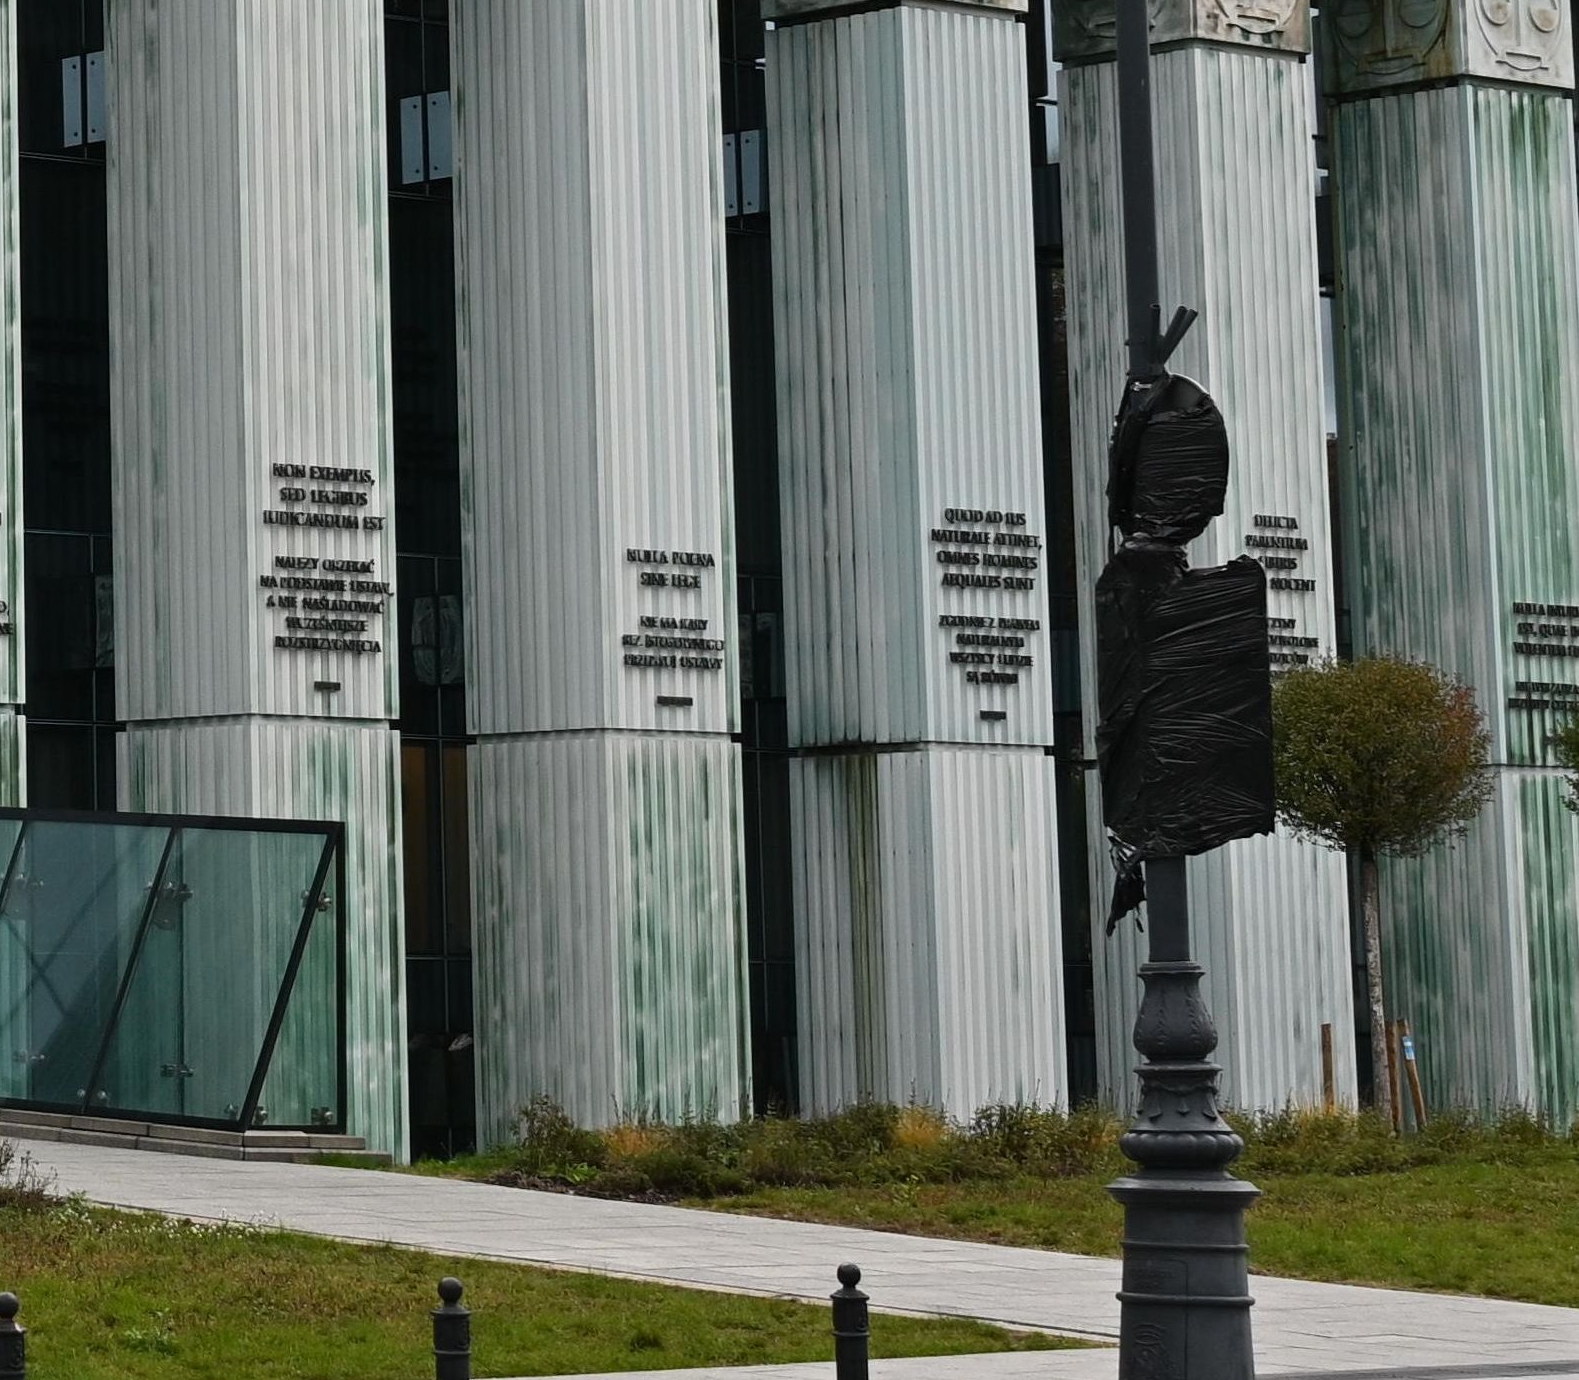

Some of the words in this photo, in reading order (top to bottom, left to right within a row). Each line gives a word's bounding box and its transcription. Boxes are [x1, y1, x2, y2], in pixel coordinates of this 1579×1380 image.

[272, 462, 306, 479] NON
[279, 487, 306, 503] SED
[310, 489, 368, 507] LEGIBUS
[363, 516, 387, 531] EST
[945, 508, 984, 524] QUOD
[985, 510, 1003, 524] AD
[931, 528, 991, 545] NATURALE
